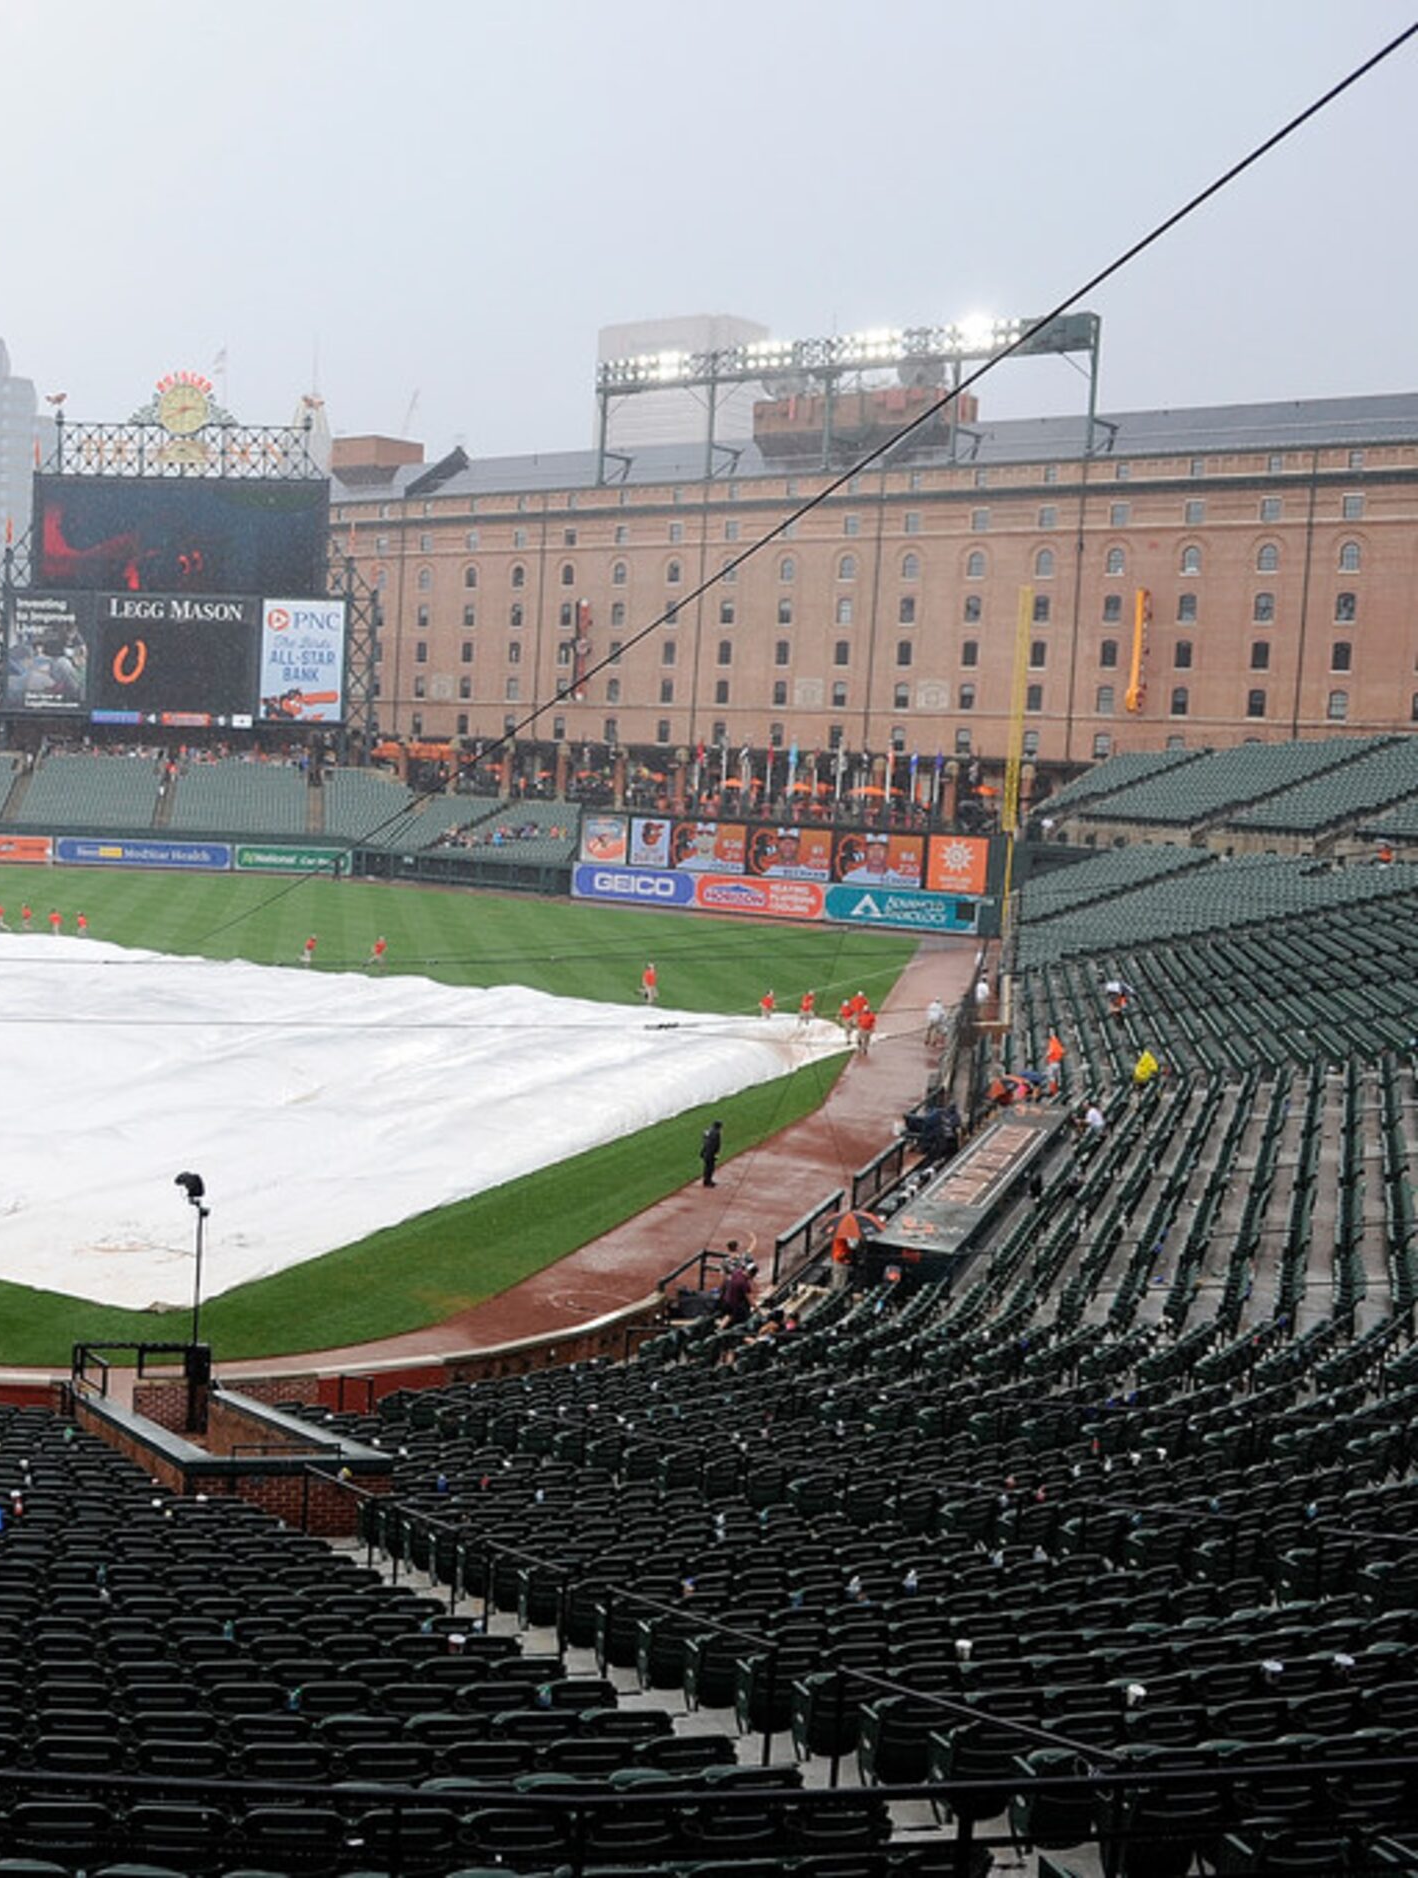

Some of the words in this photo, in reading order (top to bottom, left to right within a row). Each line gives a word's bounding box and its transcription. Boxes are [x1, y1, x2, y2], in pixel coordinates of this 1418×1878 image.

[110, 598, 165, 620] LEGG
[168, 599, 244, 622] MASON
[293, 611, 342, 631] PNC
[268, 650, 337, 666] ALL-STAR
[282, 666, 320, 682] BANK
[171, 849, 211, 863] Health
[594, 872, 675, 897] GEICO
[704, 890, 764, 906] HORIZON
